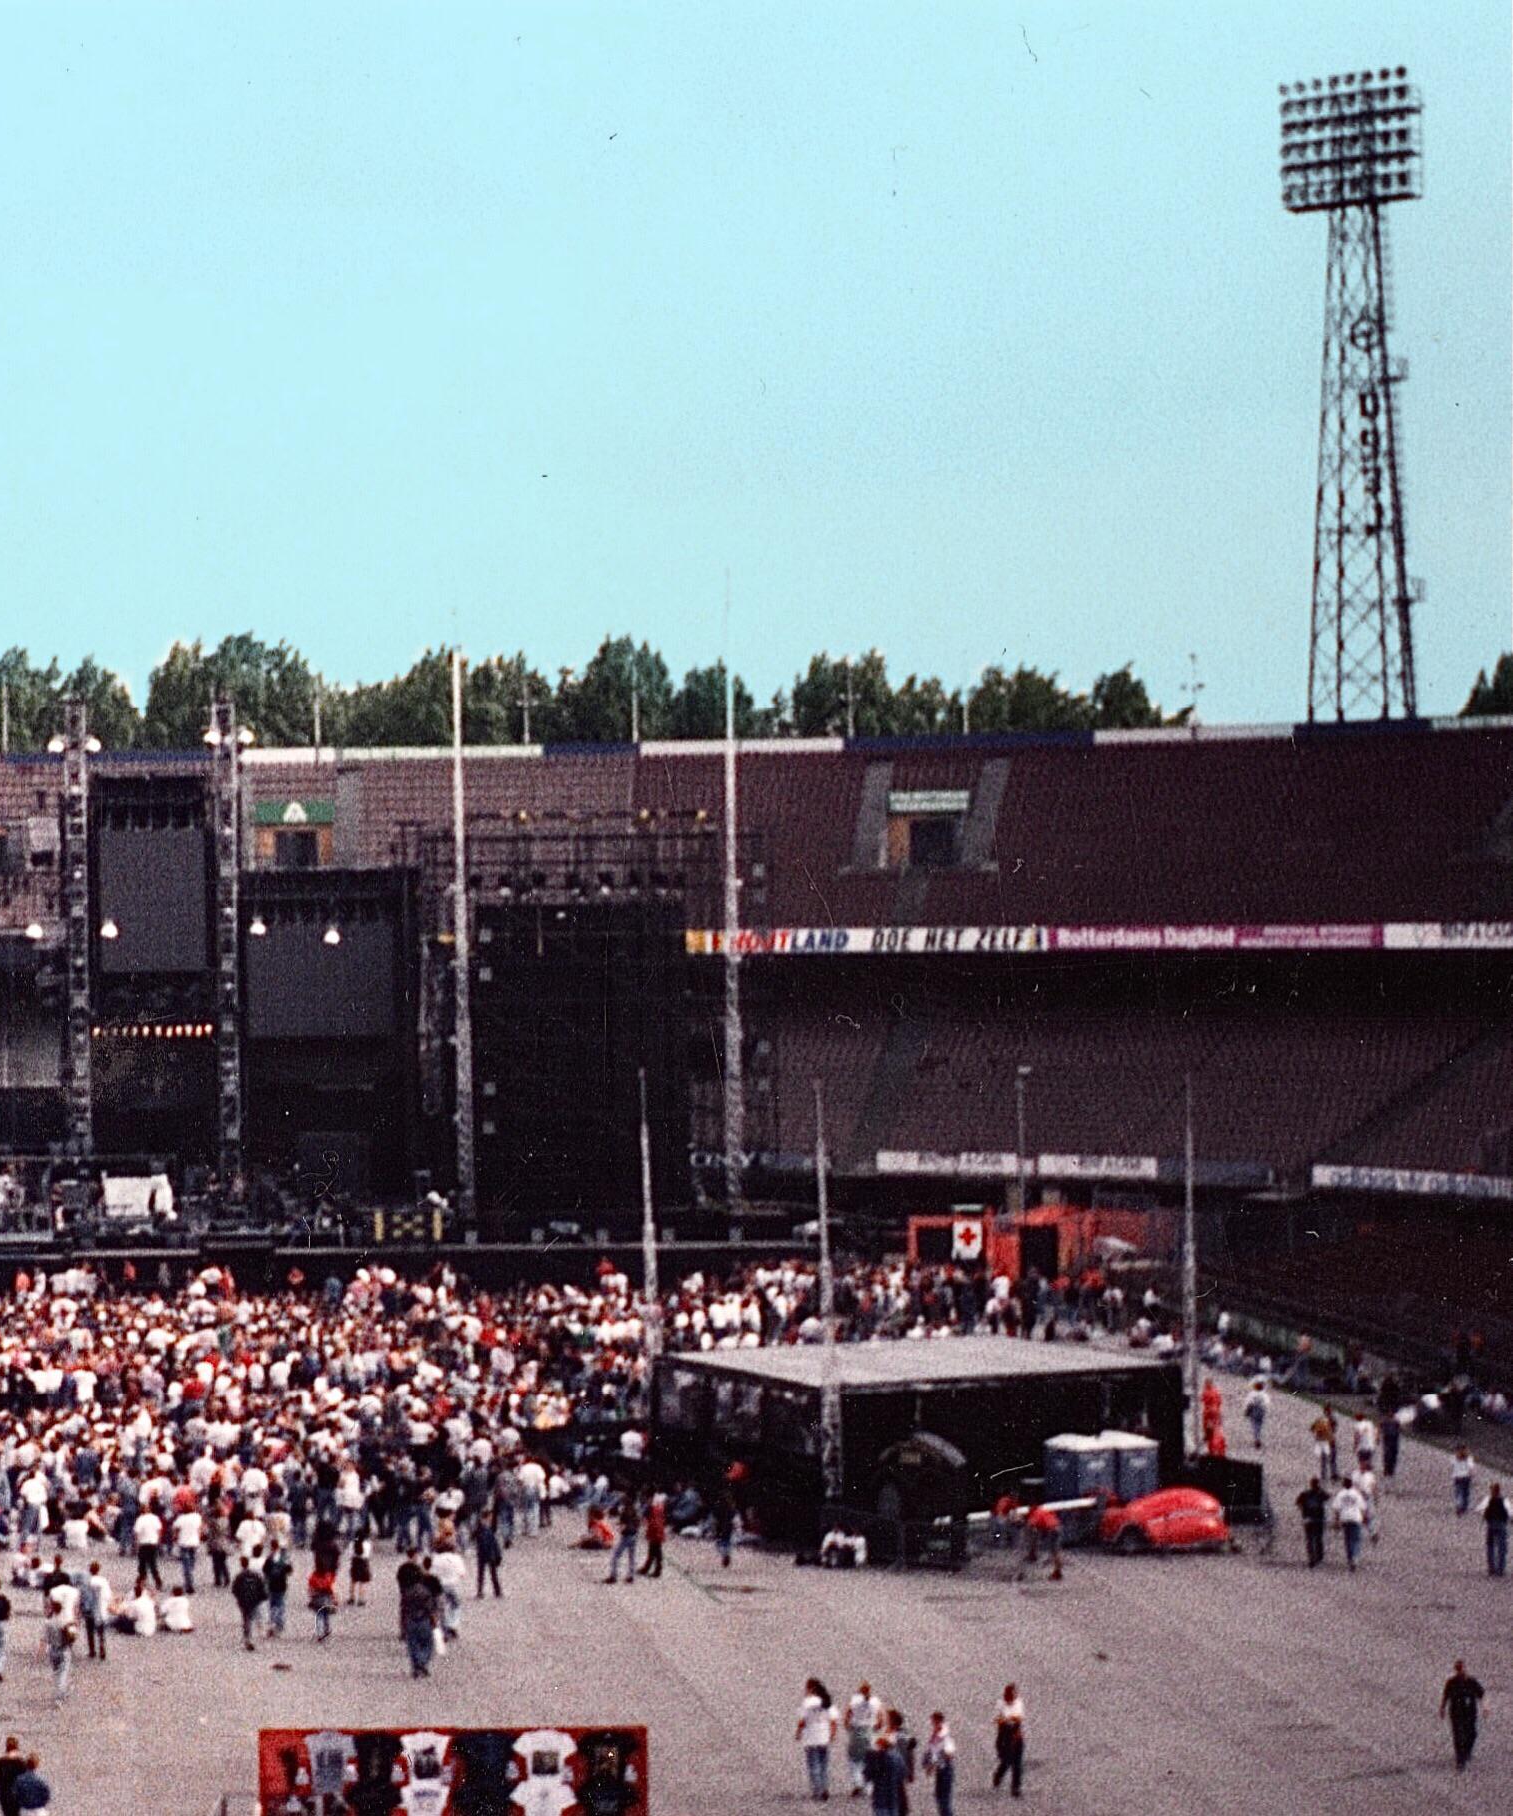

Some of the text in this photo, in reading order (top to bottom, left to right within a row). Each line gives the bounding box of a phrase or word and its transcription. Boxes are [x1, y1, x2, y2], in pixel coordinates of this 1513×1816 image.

[872, 927, 911, 951] DOE
[925, 927, 964, 951] HET
[1056, 926, 1161, 949] Rotterdams
[1164, 926, 1235, 950] Dagblad
